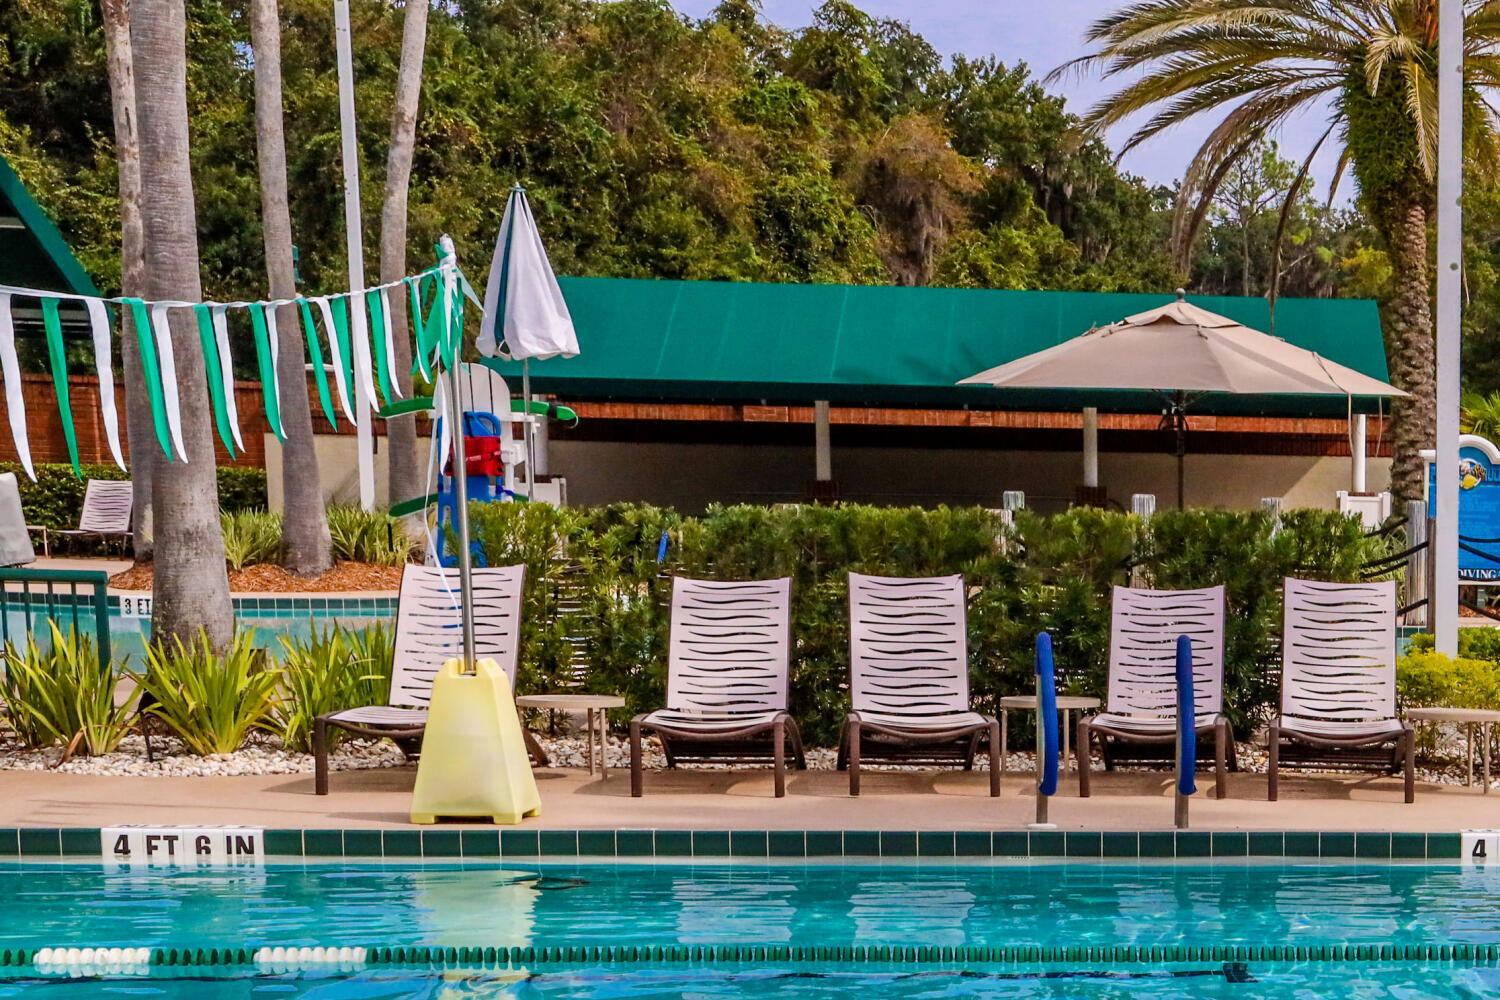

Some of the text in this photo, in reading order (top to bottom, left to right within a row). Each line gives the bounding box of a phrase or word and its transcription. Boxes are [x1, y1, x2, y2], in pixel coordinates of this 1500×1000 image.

[113, 834, 255, 855] 4 FT 6 IN
[1472, 839, 1487, 857] 4
